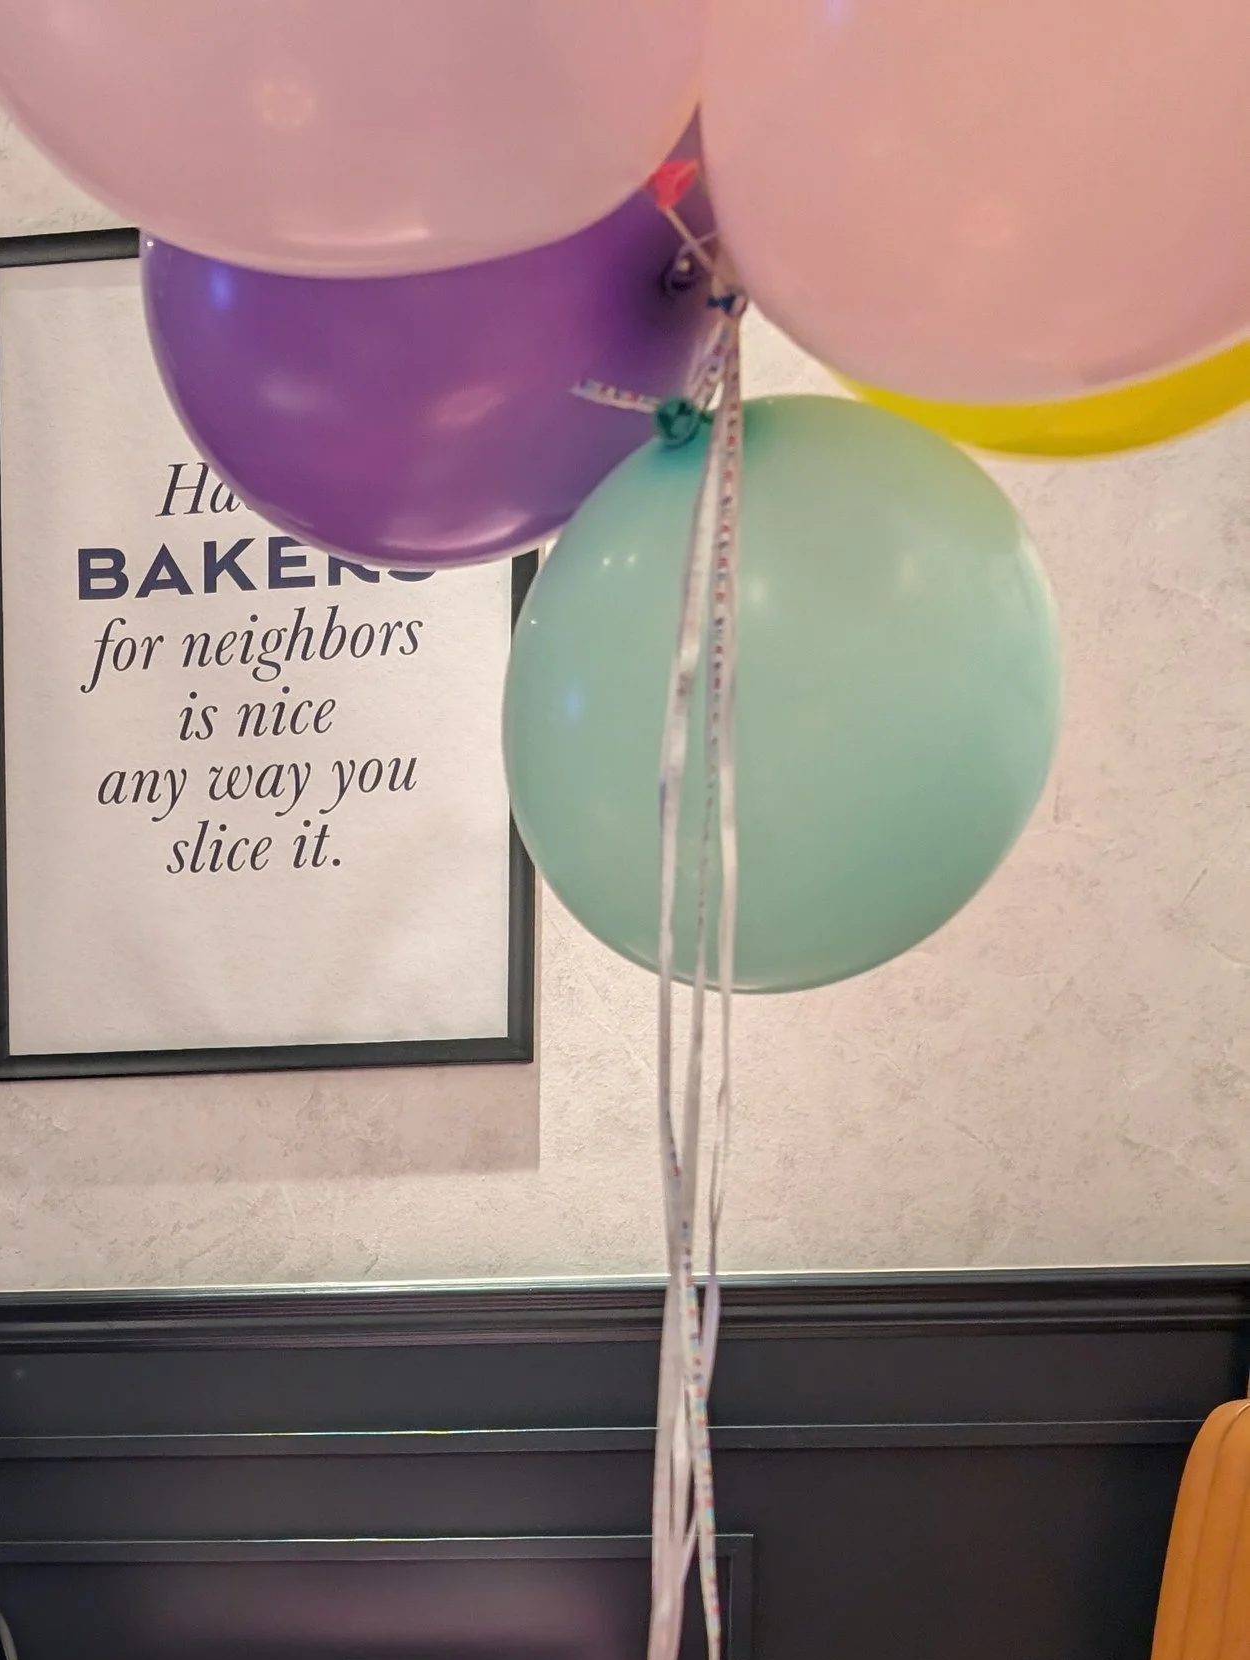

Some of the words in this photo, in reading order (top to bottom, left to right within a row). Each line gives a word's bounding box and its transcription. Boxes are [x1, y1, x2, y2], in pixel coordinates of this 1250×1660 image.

[155, 462, 254, 517] Ha
[80, 617, 164, 694] for
[182, 605, 423, 682] neighbors
[179, 691, 218, 741] is
[237, 686, 336, 737] nice
[97, 768, 187, 823] any
[208, 762, 311, 817] way
[325, 757, 417, 814] you
[166, 820, 273, 874] slice
[293, 819, 341, 869] it.
